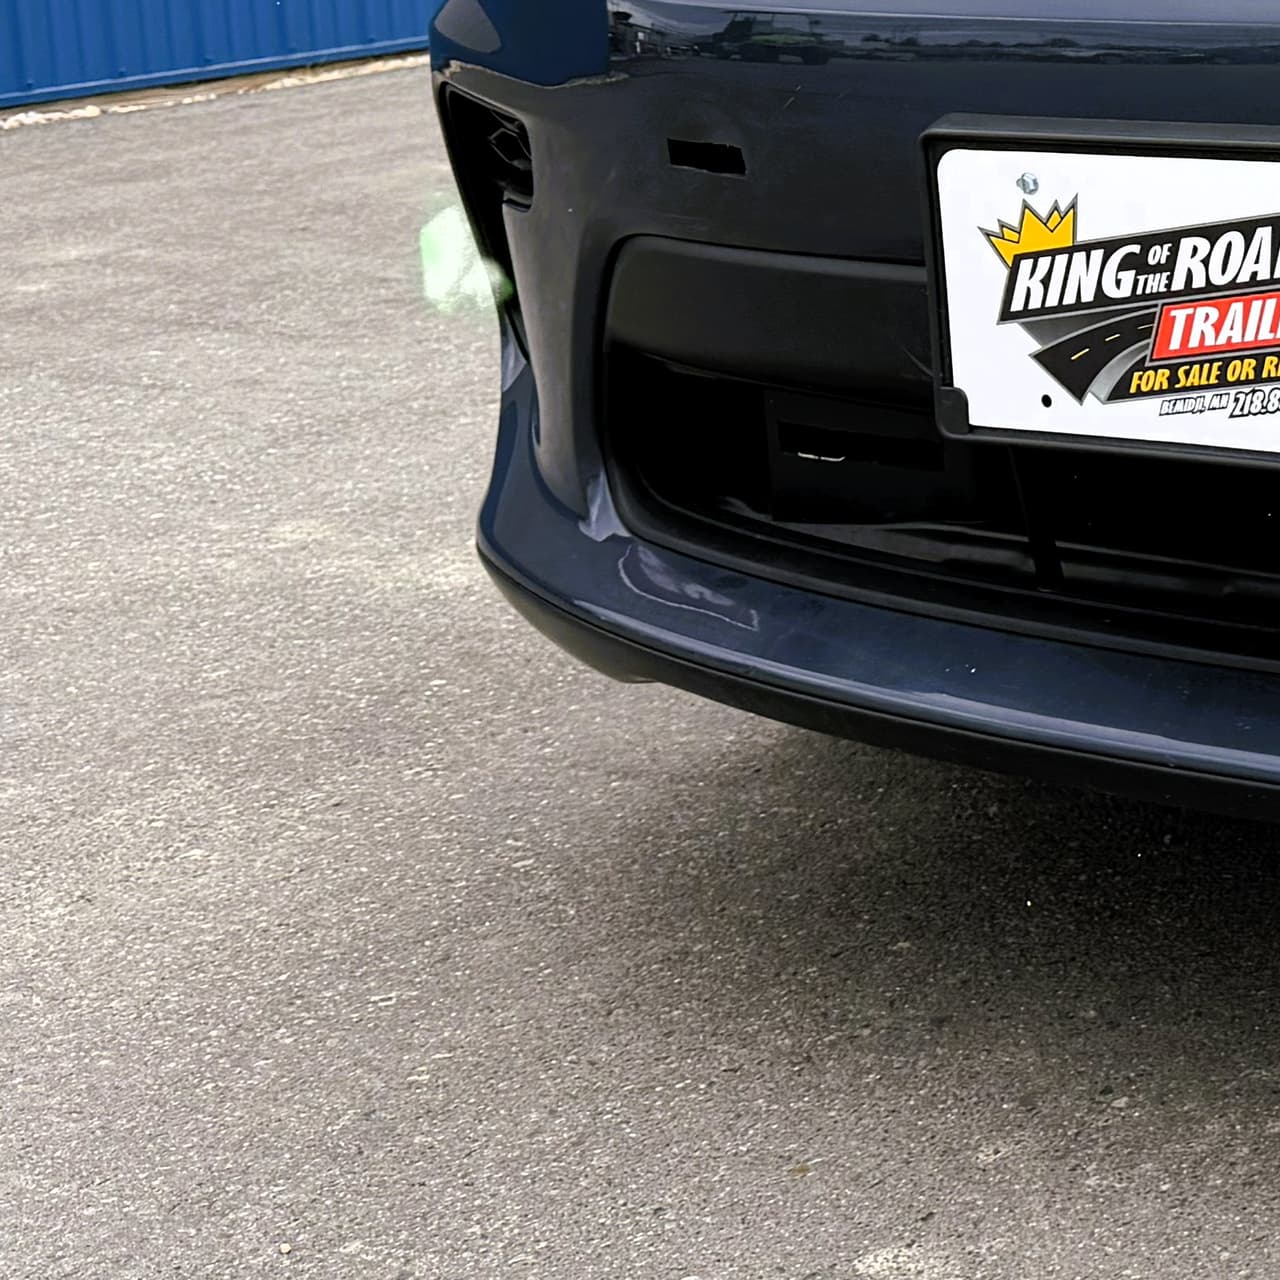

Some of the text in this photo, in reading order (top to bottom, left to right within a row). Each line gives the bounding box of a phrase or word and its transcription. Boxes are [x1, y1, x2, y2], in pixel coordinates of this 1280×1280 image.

[1147, 242, 1173, 266] OF
[1009, 243, 1142, 313] KING
[1135, 271, 1172, 297] THE
[1129, 368, 1171, 394] FOR
[1174, 361, 1222, 389] SALE
[1226, 357, 1257, 384] OR
